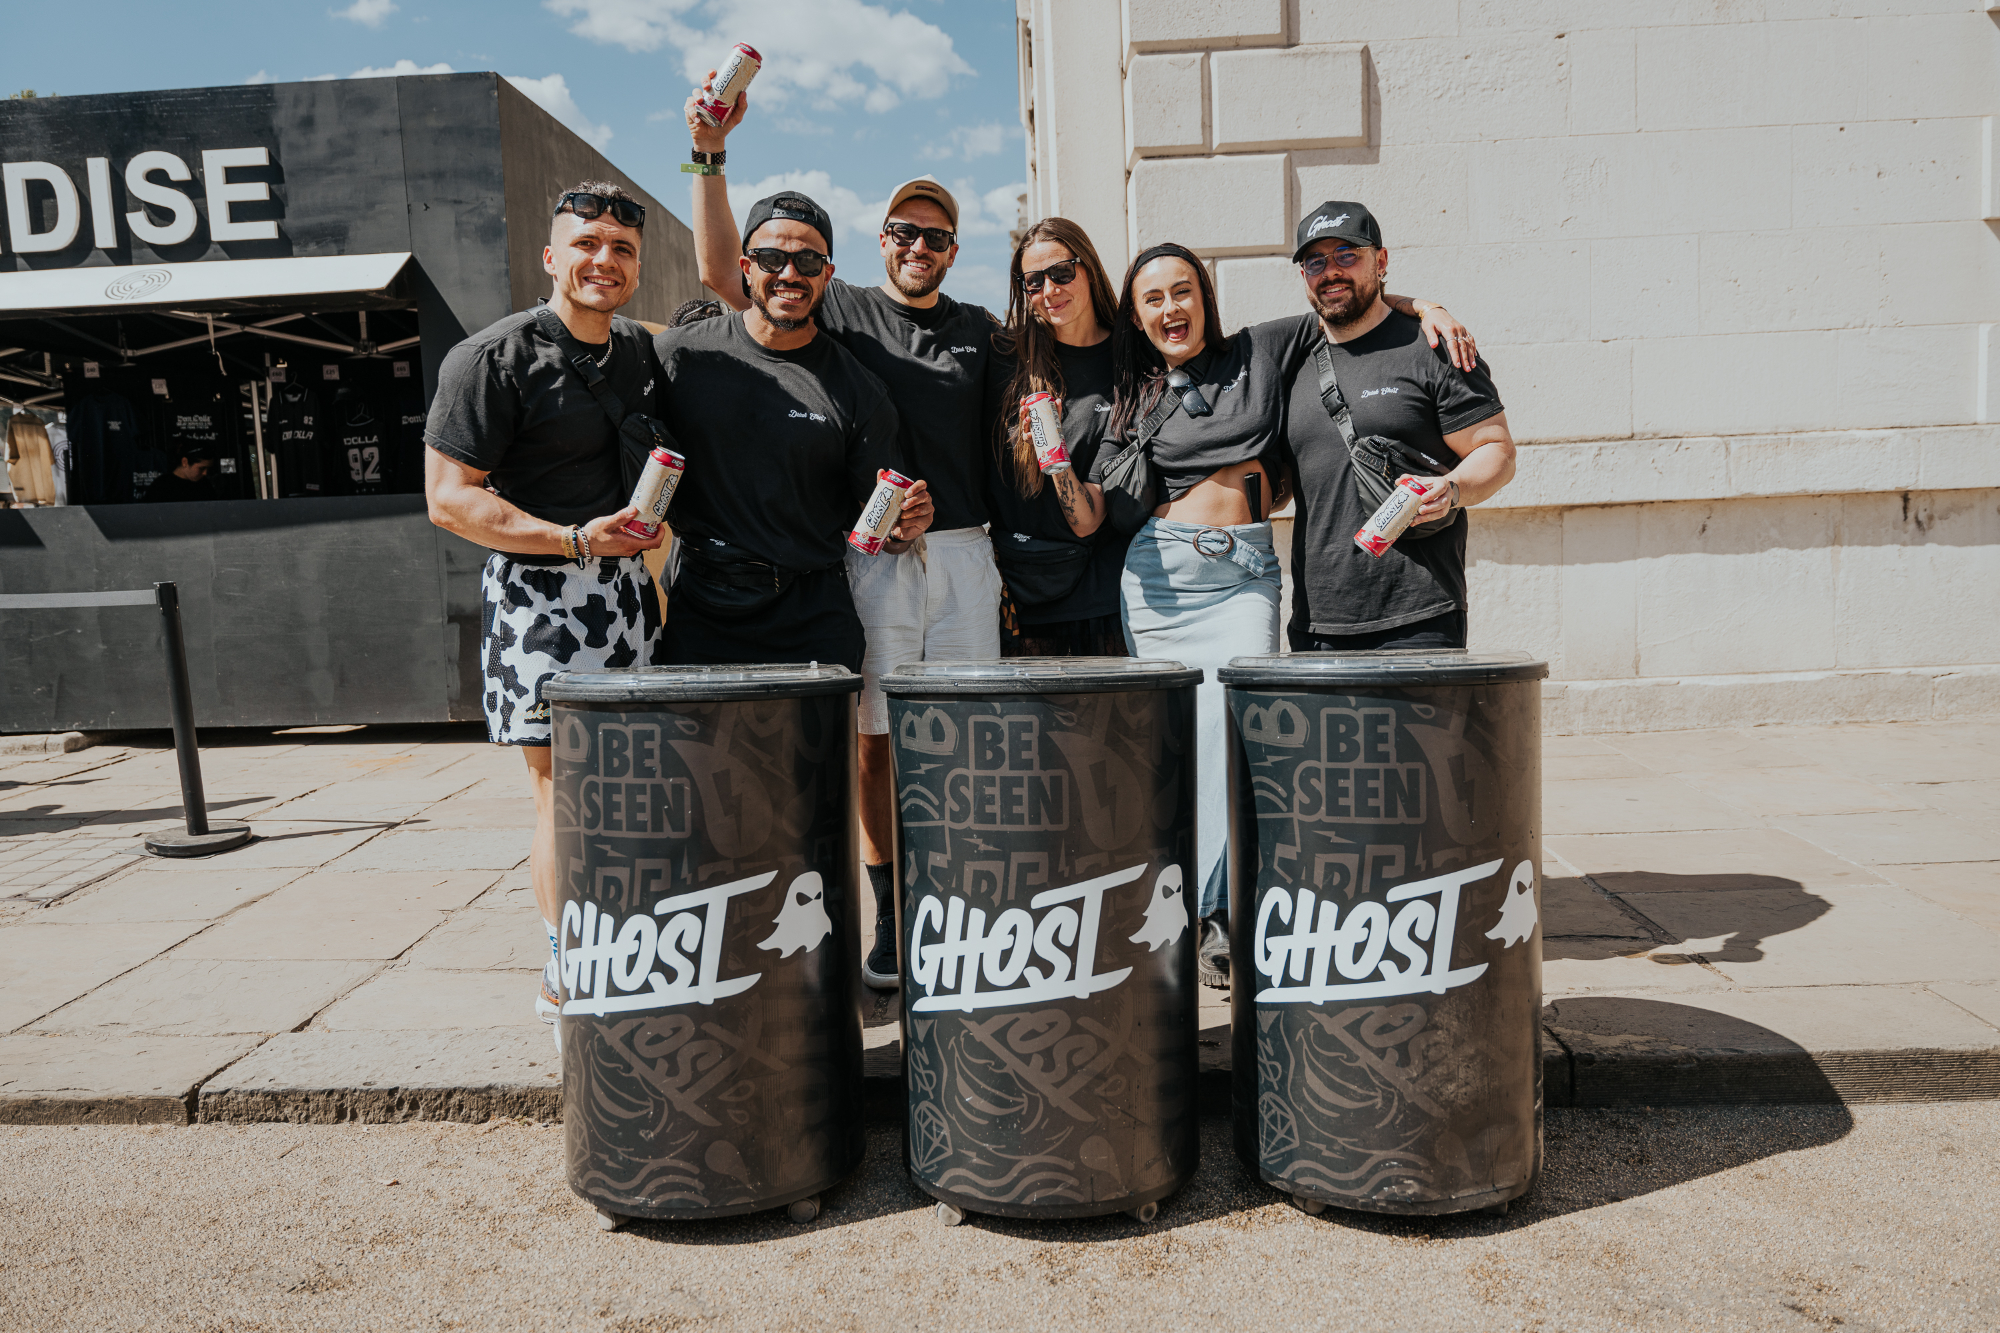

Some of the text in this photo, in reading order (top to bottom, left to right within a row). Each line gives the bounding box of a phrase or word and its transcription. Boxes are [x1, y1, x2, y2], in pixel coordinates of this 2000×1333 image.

[0, 146, 279, 254] DISE
[1307, 213, 1350, 237] Ghost
[343, 434, 379, 446] DOLLA
[347, 446, 381, 484] 92
[1103, 450, 1130, 477] GHOST
[653, 478, 676, 517] GHOST
[866, 493, 890, 531] GHOST
[1374, 495, 1403, 532] GHOST
[600, 726, 658, 778] BE
[973, 718, 1035, 771] BE
[1325, 712, 1391, 763] BE
[581, 779, 688, 834] SEEN
[947, 773, 1066, 826] SEEN
[1298, 767, 1422, 819] SEEN
[561, 869, 779, 1017] GHOST
[911, 862, 1148, 1013] GHOST
[1254, 857, 1504, 1006] GHOST
